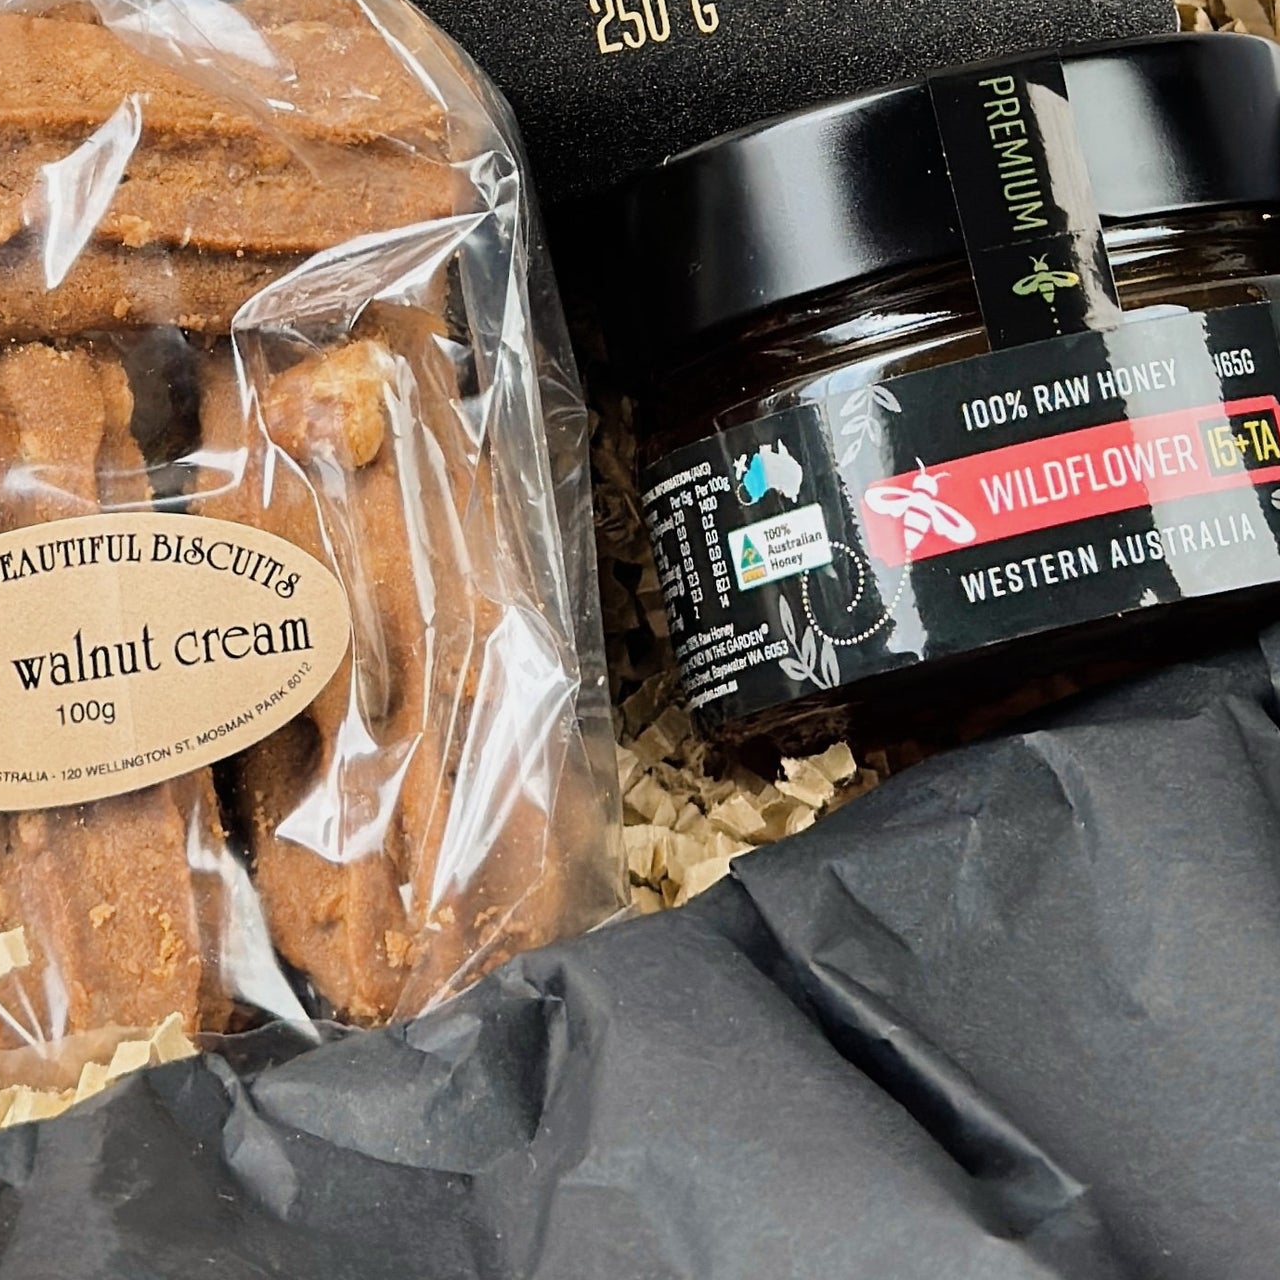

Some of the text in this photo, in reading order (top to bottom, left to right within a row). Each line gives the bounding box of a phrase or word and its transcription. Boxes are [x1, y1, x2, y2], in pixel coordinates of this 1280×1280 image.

[978, 75, 1048, 231] PREMIUM
[962, 358, 1177, 431] 100% RAW HONEY
[695, 484, 708, 499] Per
[708, 476, 731, 493] 100g
[980, 434, 1199, 515] WILDFLOWER
[764, 523, 791, 542] 100%
[768, 532, 822, 556] Australian
[770, 553, 803, 571] Honey
[961, 512, 1256, 604] WESTERN AUSTRALIA
[150, 534, 302, 599] BISCUITS
[12, 623, 161, 691] walnut
[174, 616, 313, 667] cream
[746, 648, 765, 666] WA
[764, 640, 789, 660] 6053
[56, 700, 116, 727] 100g
[61, 768, 82, 781] 120
[86, 746, 171, 777] WELLINGTON
[196, 711, 254, 746] MOSMAN
[254, 686, 289, 715] PARK
[287, 661, 313, 690] 6012
